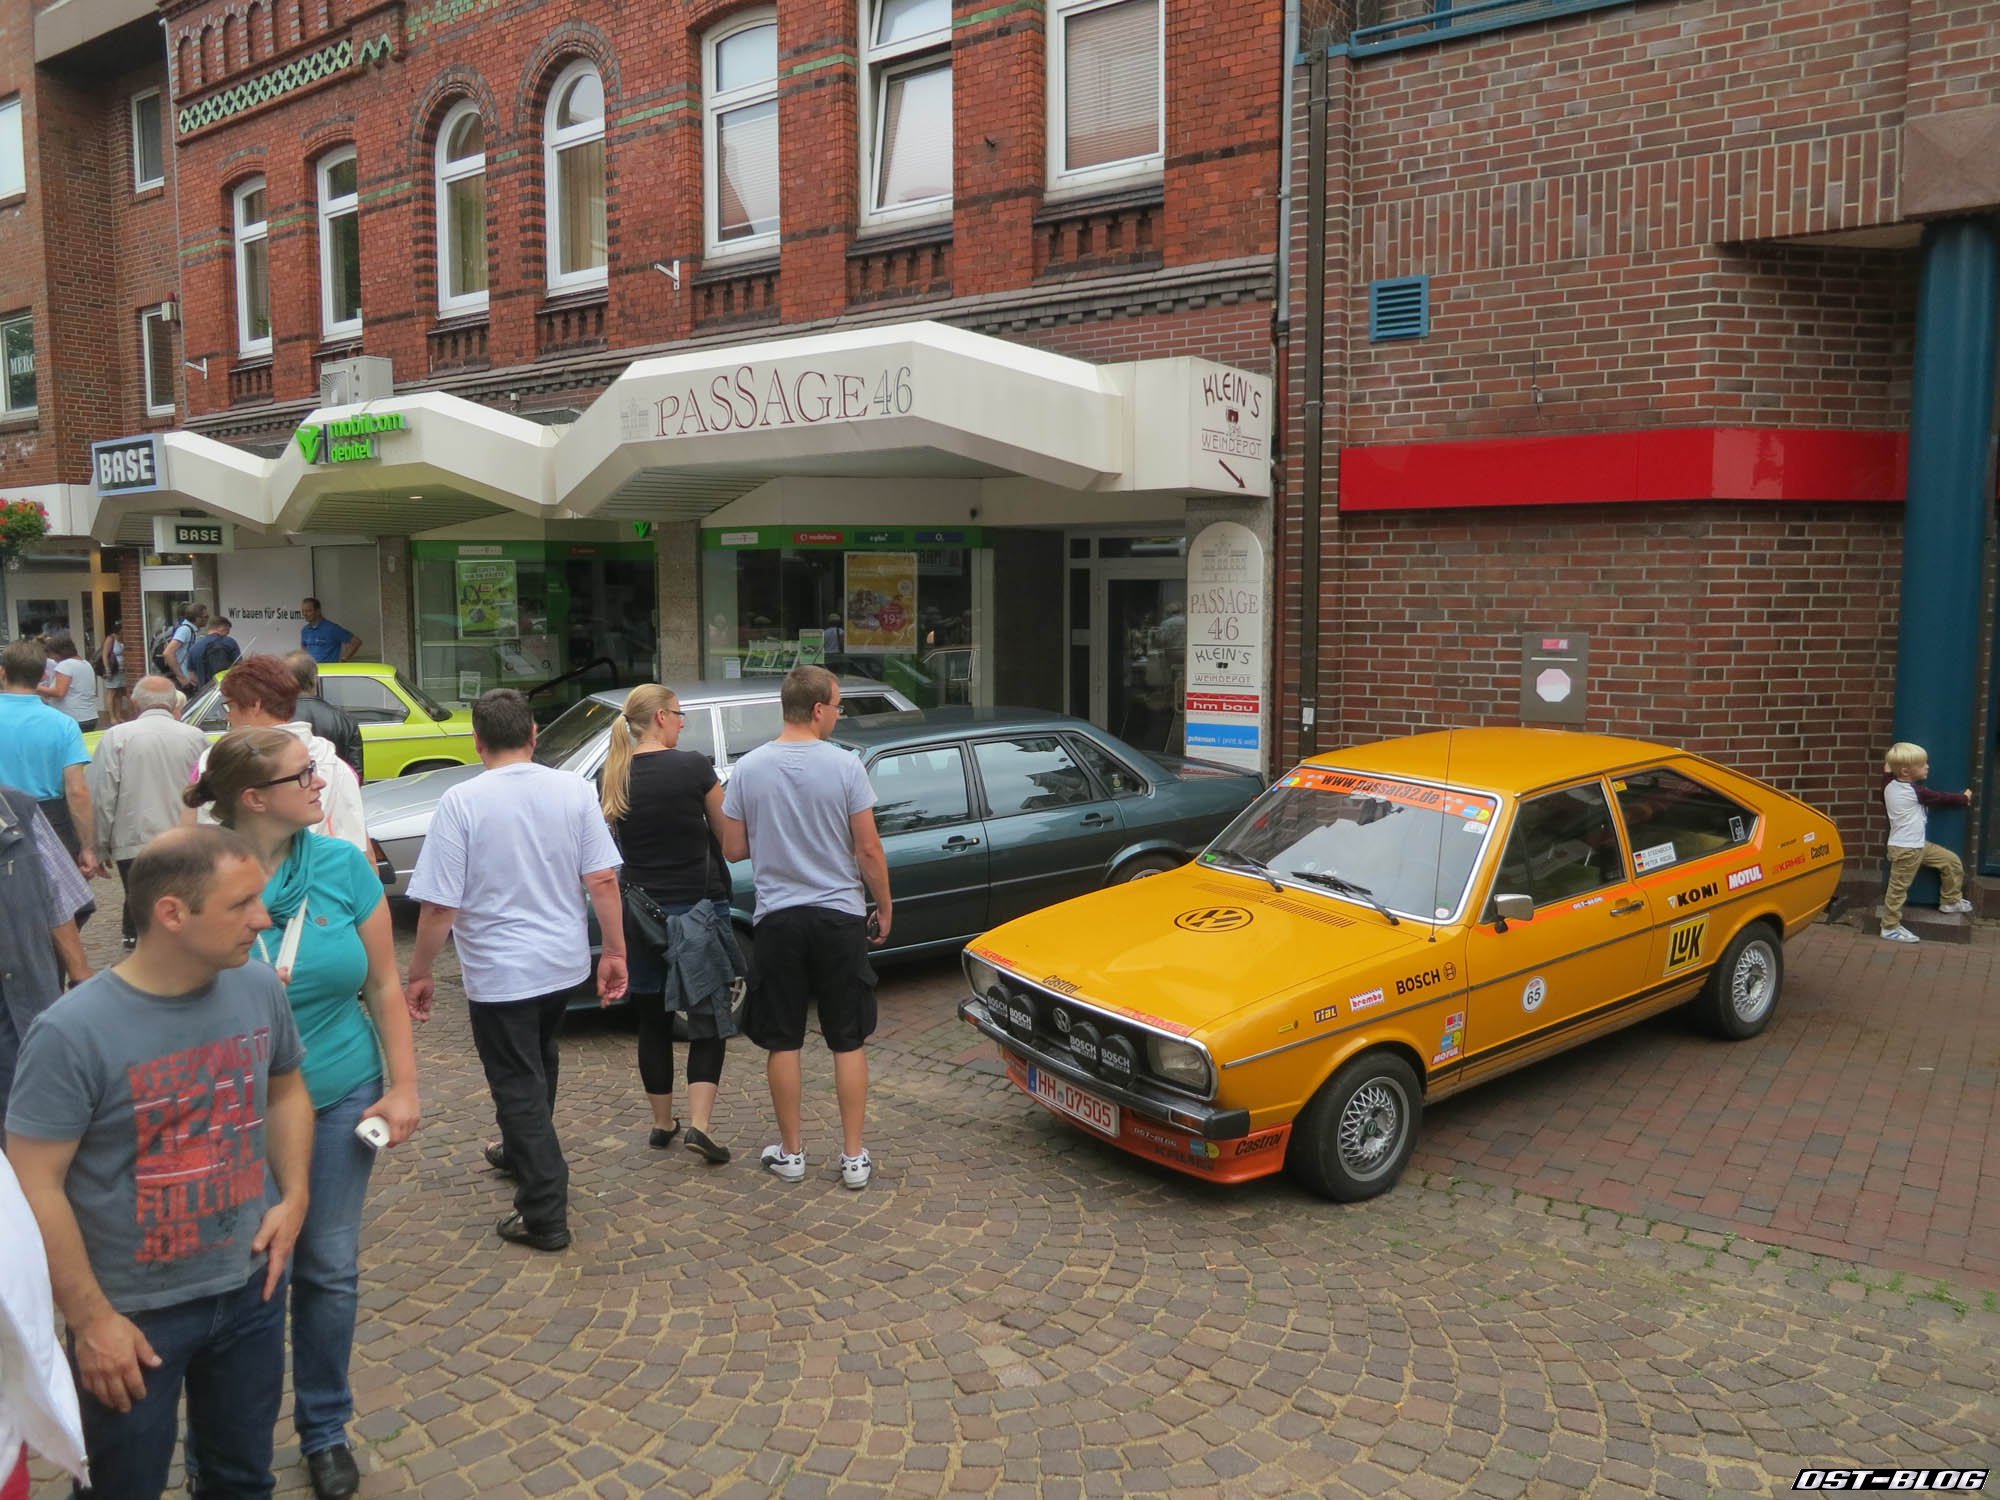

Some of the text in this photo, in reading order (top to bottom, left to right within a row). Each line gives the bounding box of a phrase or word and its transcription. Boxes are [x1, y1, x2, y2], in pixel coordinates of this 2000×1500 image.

[654, 366, 913, 437] PASSAGE 46
[1203, 372, 1262, 418] KLEIN'S
[330, 413, 406, 438] mobilcom
[332, 439, 373, 463] debitel
[1201, 431, 1261, 457] WEINDEPOT
[100, 447, 153, 484] BASE
[179, 529, 219, 542] BASE
[1191, 587, 1258, 614] PASSAGE
[228, 607, 240, 619] Wir
[242, 607, 263, 619] bauen
[277, 607, 288, 619] Sie
[1208, 616, 1239, 640] 46
[1195, 648, 1251, 664] KLEIN'S
[1193, 701, 1253, 712] hm bau
[1728, 866, 1762, 890] MOTUL
[1677, 883, 1718, 907] KONI
[1042, 974, 1082, 995] Castrol
[1396, 969, 1441, 995] BOSCH
[1352, 994, 1383, 1008] brembo
[1527, 987, 1541, 1005] 65
[1010, 1007, 1032, 1023] BOSCH
[1070, 1035, 1097, 1053] BOSCH
[128, 1034, 254, 1099] KEEPING
[1101, 1048, 1130, 1070] BOSCH
[1038, 1070, 1111, 1128] HH 07505
[134, 1069, 264, 1154] REAL
[1235, 1131, 1284, 1156] Castrol
